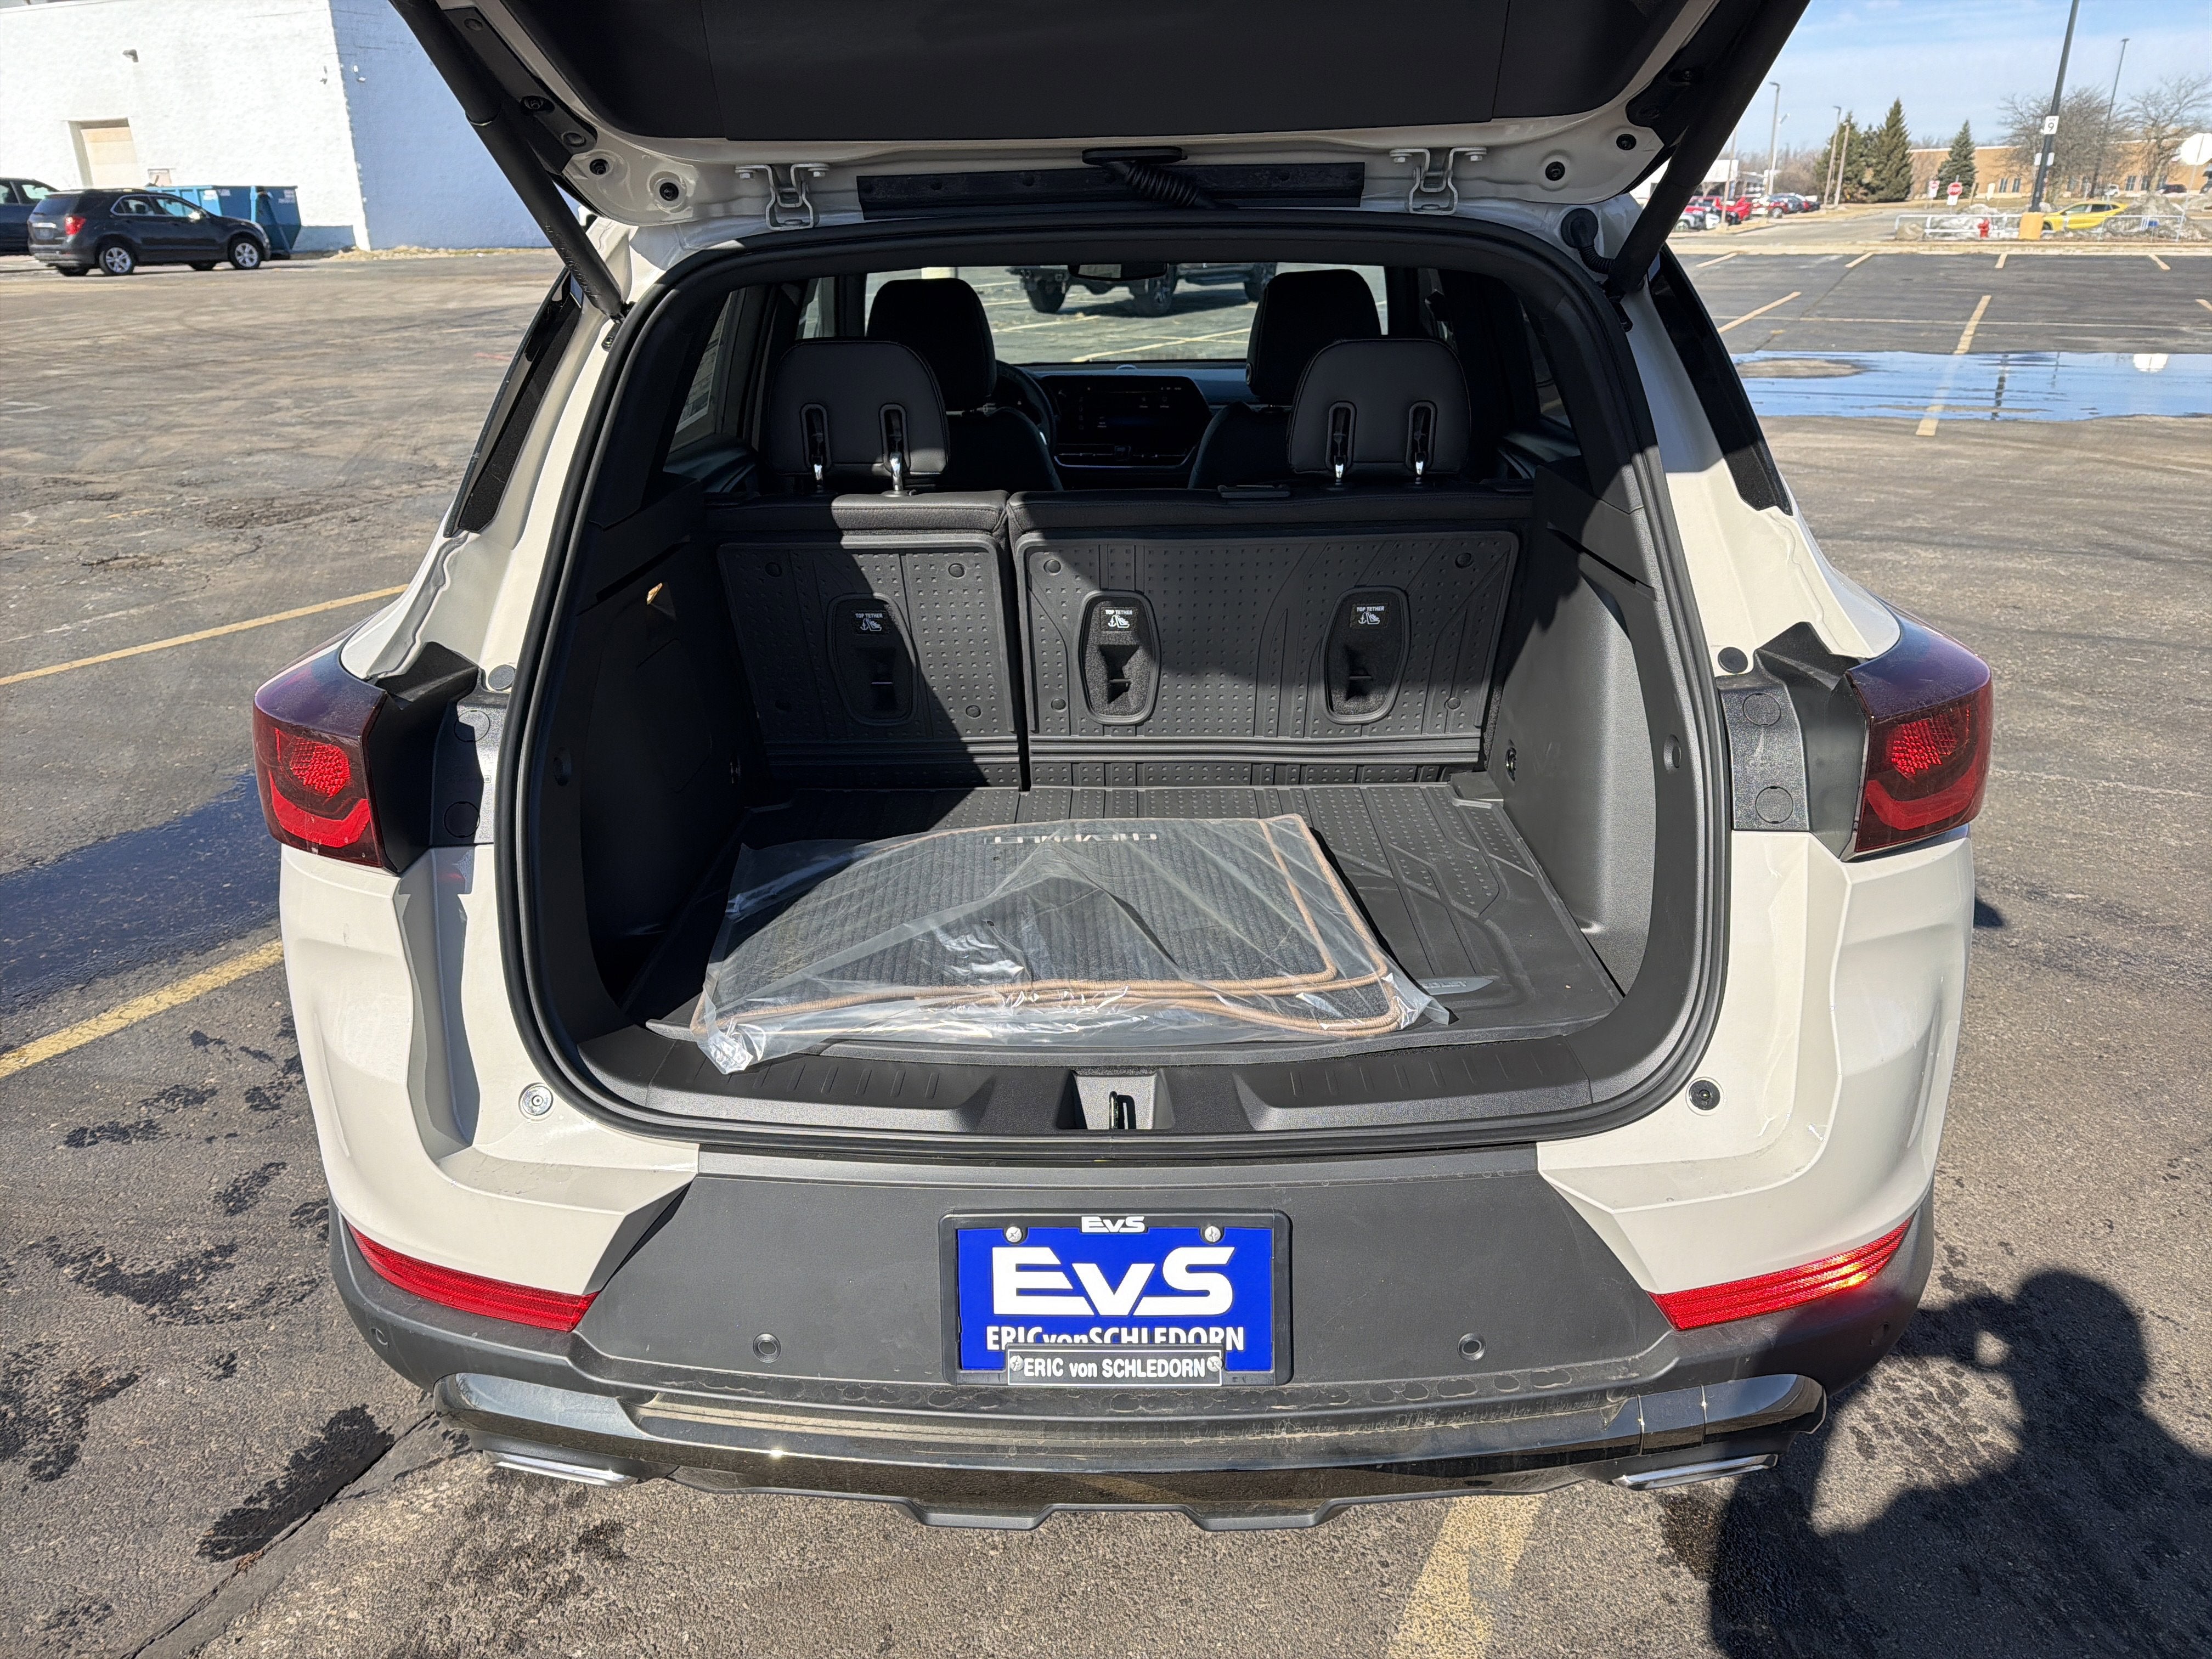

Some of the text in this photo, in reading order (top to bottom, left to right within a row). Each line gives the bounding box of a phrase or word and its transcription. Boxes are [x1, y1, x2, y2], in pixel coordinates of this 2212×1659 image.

[2047, 122, 2055, 132] 9
[1024, 1357, 1205, 1378] ERIC von SCHLEDORN
